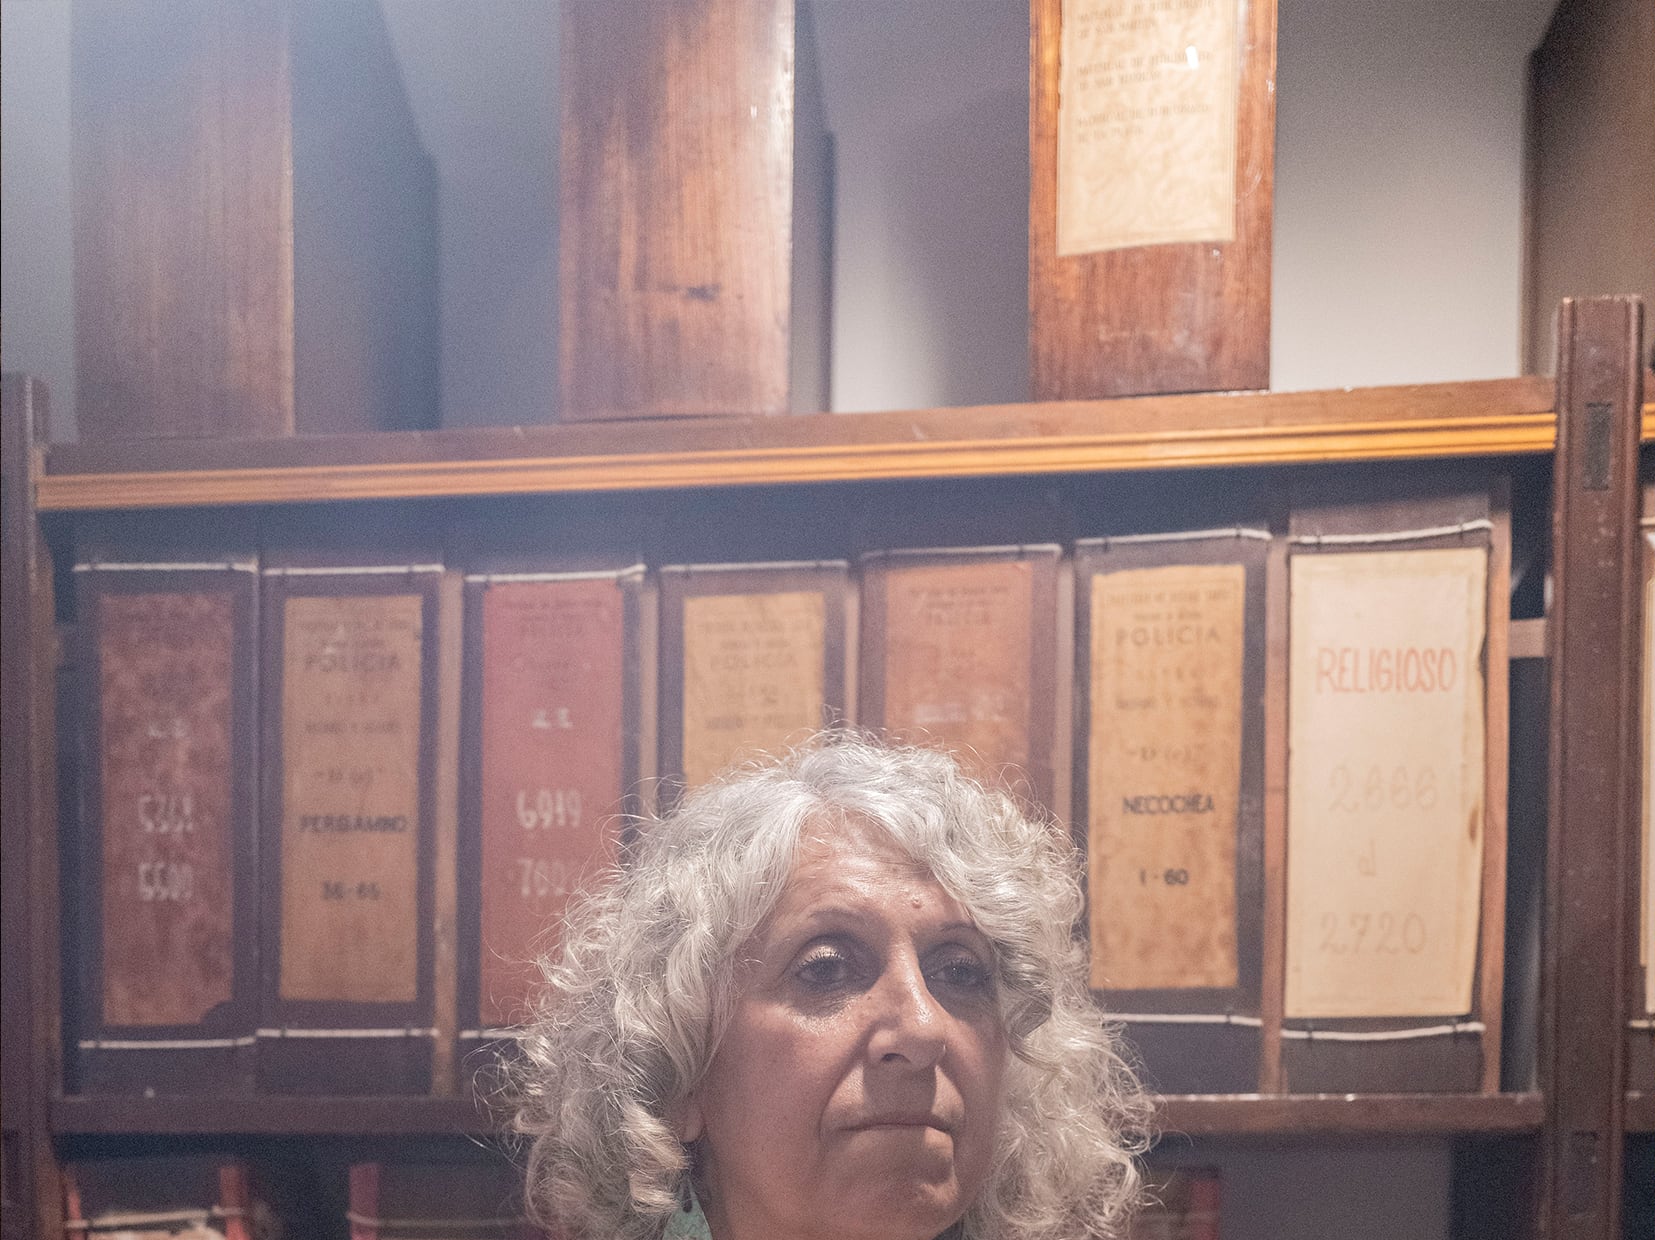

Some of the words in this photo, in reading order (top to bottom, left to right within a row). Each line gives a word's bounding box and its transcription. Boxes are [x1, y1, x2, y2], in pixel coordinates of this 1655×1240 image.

[1114, 624, 1222, 647] POLICIA
[1315, 646, 1458, 694] RELIGIOSO
[1121, 793, 1217, 816] NECOCHEA
